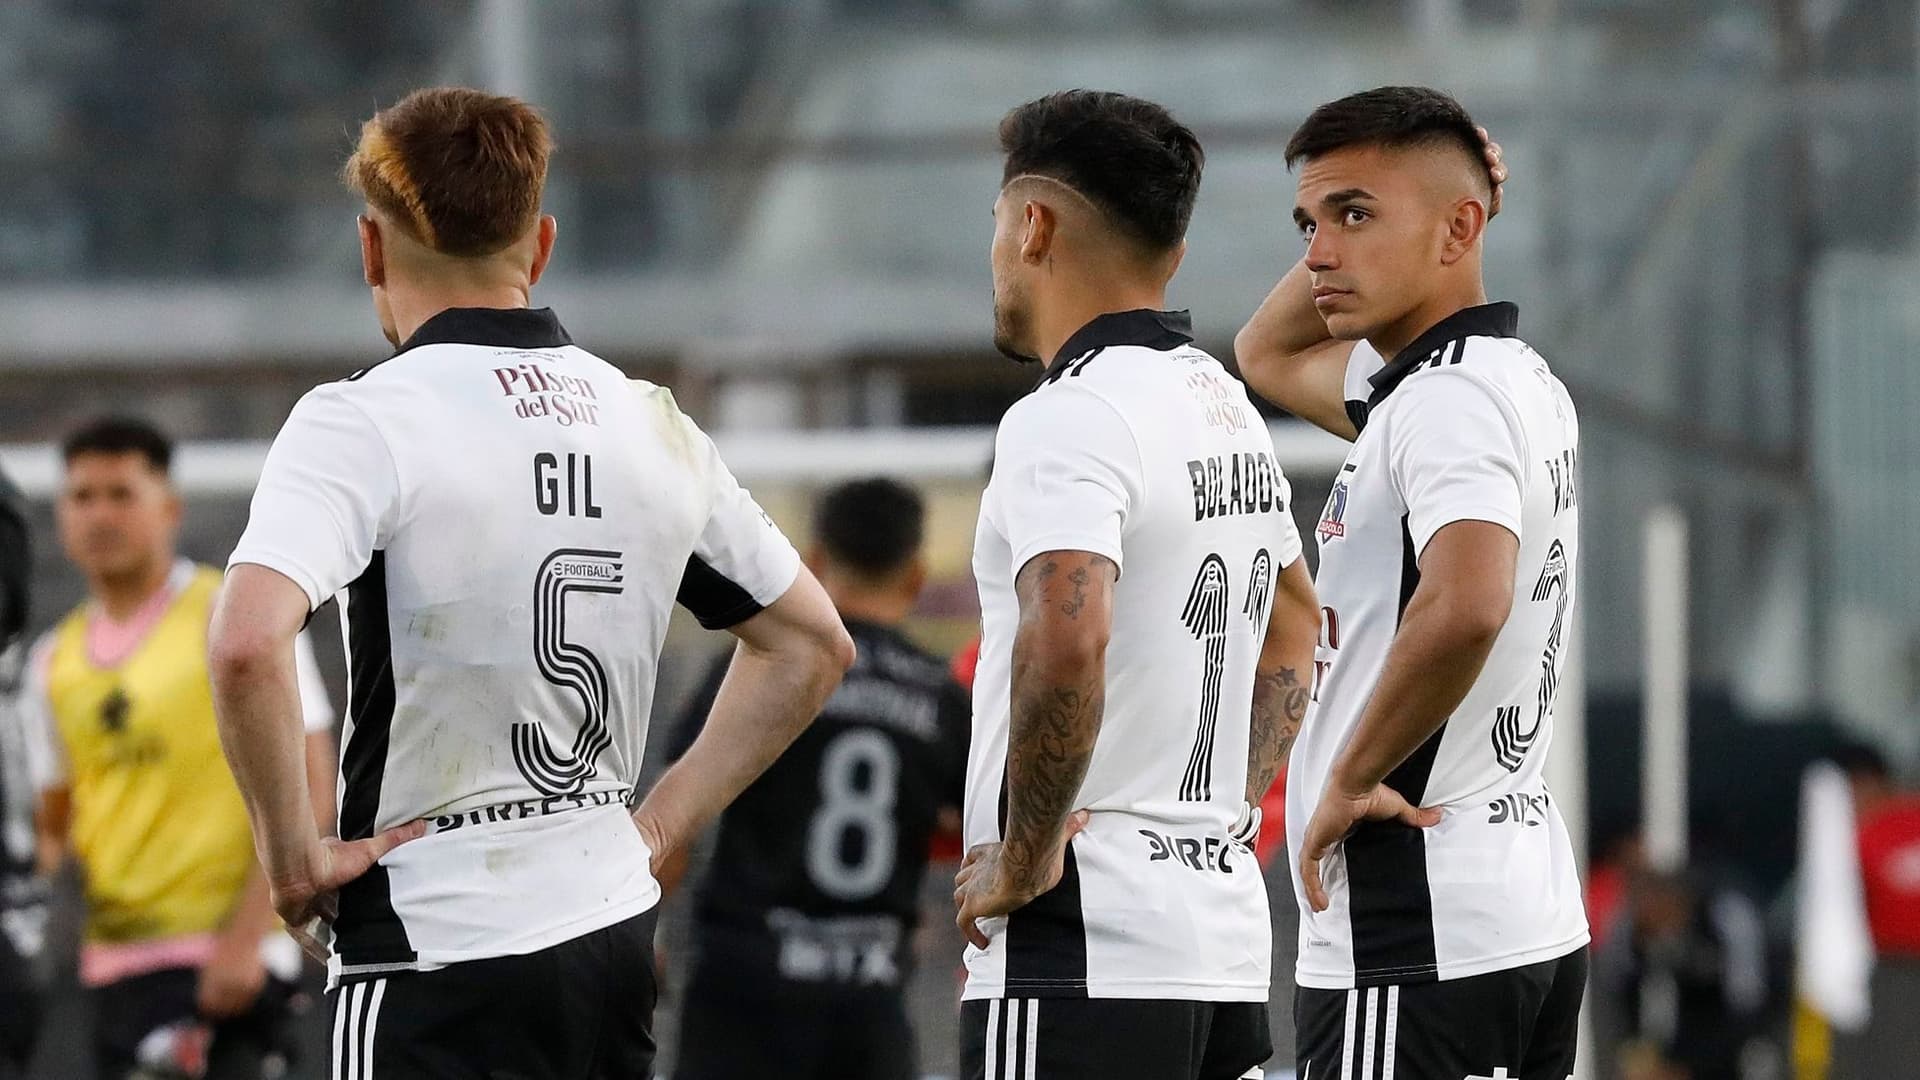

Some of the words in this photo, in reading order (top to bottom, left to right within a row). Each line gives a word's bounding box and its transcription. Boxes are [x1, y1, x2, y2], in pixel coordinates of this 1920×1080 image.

[491, 363, 598, 400] Pilsen
[514, 395, 551, 420] del
[551, 394, 600, 427] Sur
[533, 451, 602, 519] GIL
[1187, 451, 1285, 522] BOLADOS
[511, 548, 624, 797] 5
[1179, 547, 1271, 802] 11
[803, 728, 900, 902] 8
